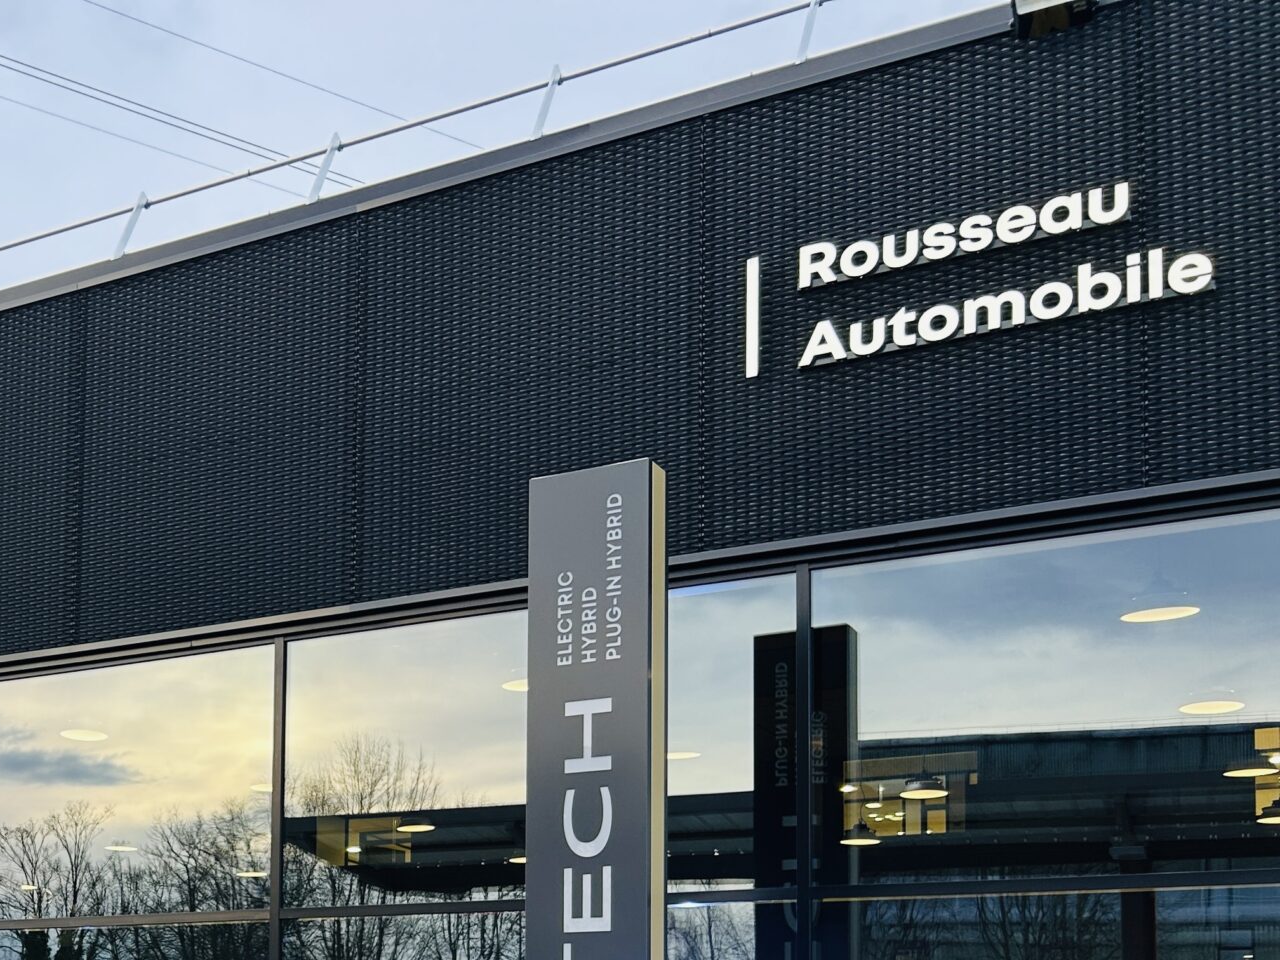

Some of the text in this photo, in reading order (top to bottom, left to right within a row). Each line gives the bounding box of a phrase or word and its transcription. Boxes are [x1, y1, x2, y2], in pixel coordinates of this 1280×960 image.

[798, 182, 1131, 290] Rousseau
[798, 247, 1214, 369] Automobile
[557, 571, 573, 666] ELECTRIC
[581, 586, 597, 663] HYBRID
[605, 493, 623, 660] PLUG-IN HYBRID
